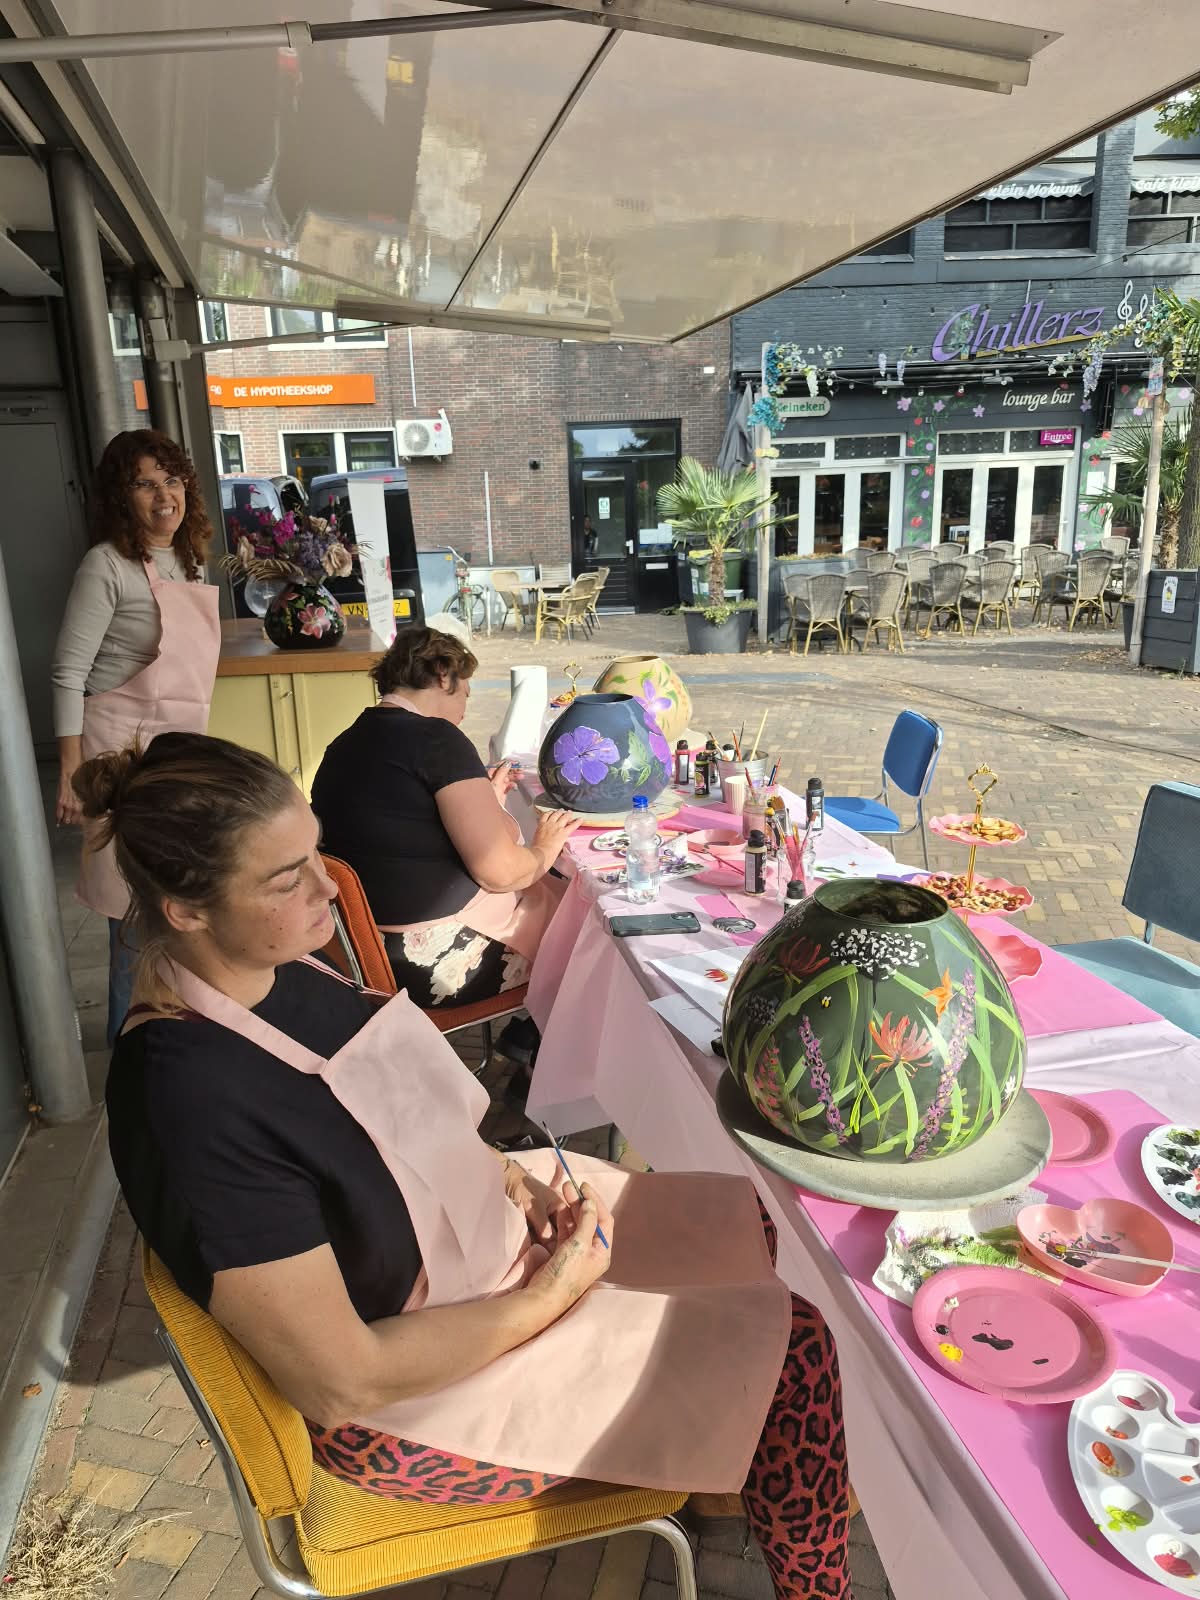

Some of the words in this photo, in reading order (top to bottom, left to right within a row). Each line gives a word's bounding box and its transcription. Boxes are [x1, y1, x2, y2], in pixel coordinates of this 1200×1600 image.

[1026, 182, 1081, 195] Mokum
[931, 299, 1105, 362] Chillerz
[233, 386, 248, 397] DE
[250, 384, 333, 397] HYPOTHEEKSHOP
[1002, 389, 1048, 412] lounge
[1050, 387, 1076, 405] bar
